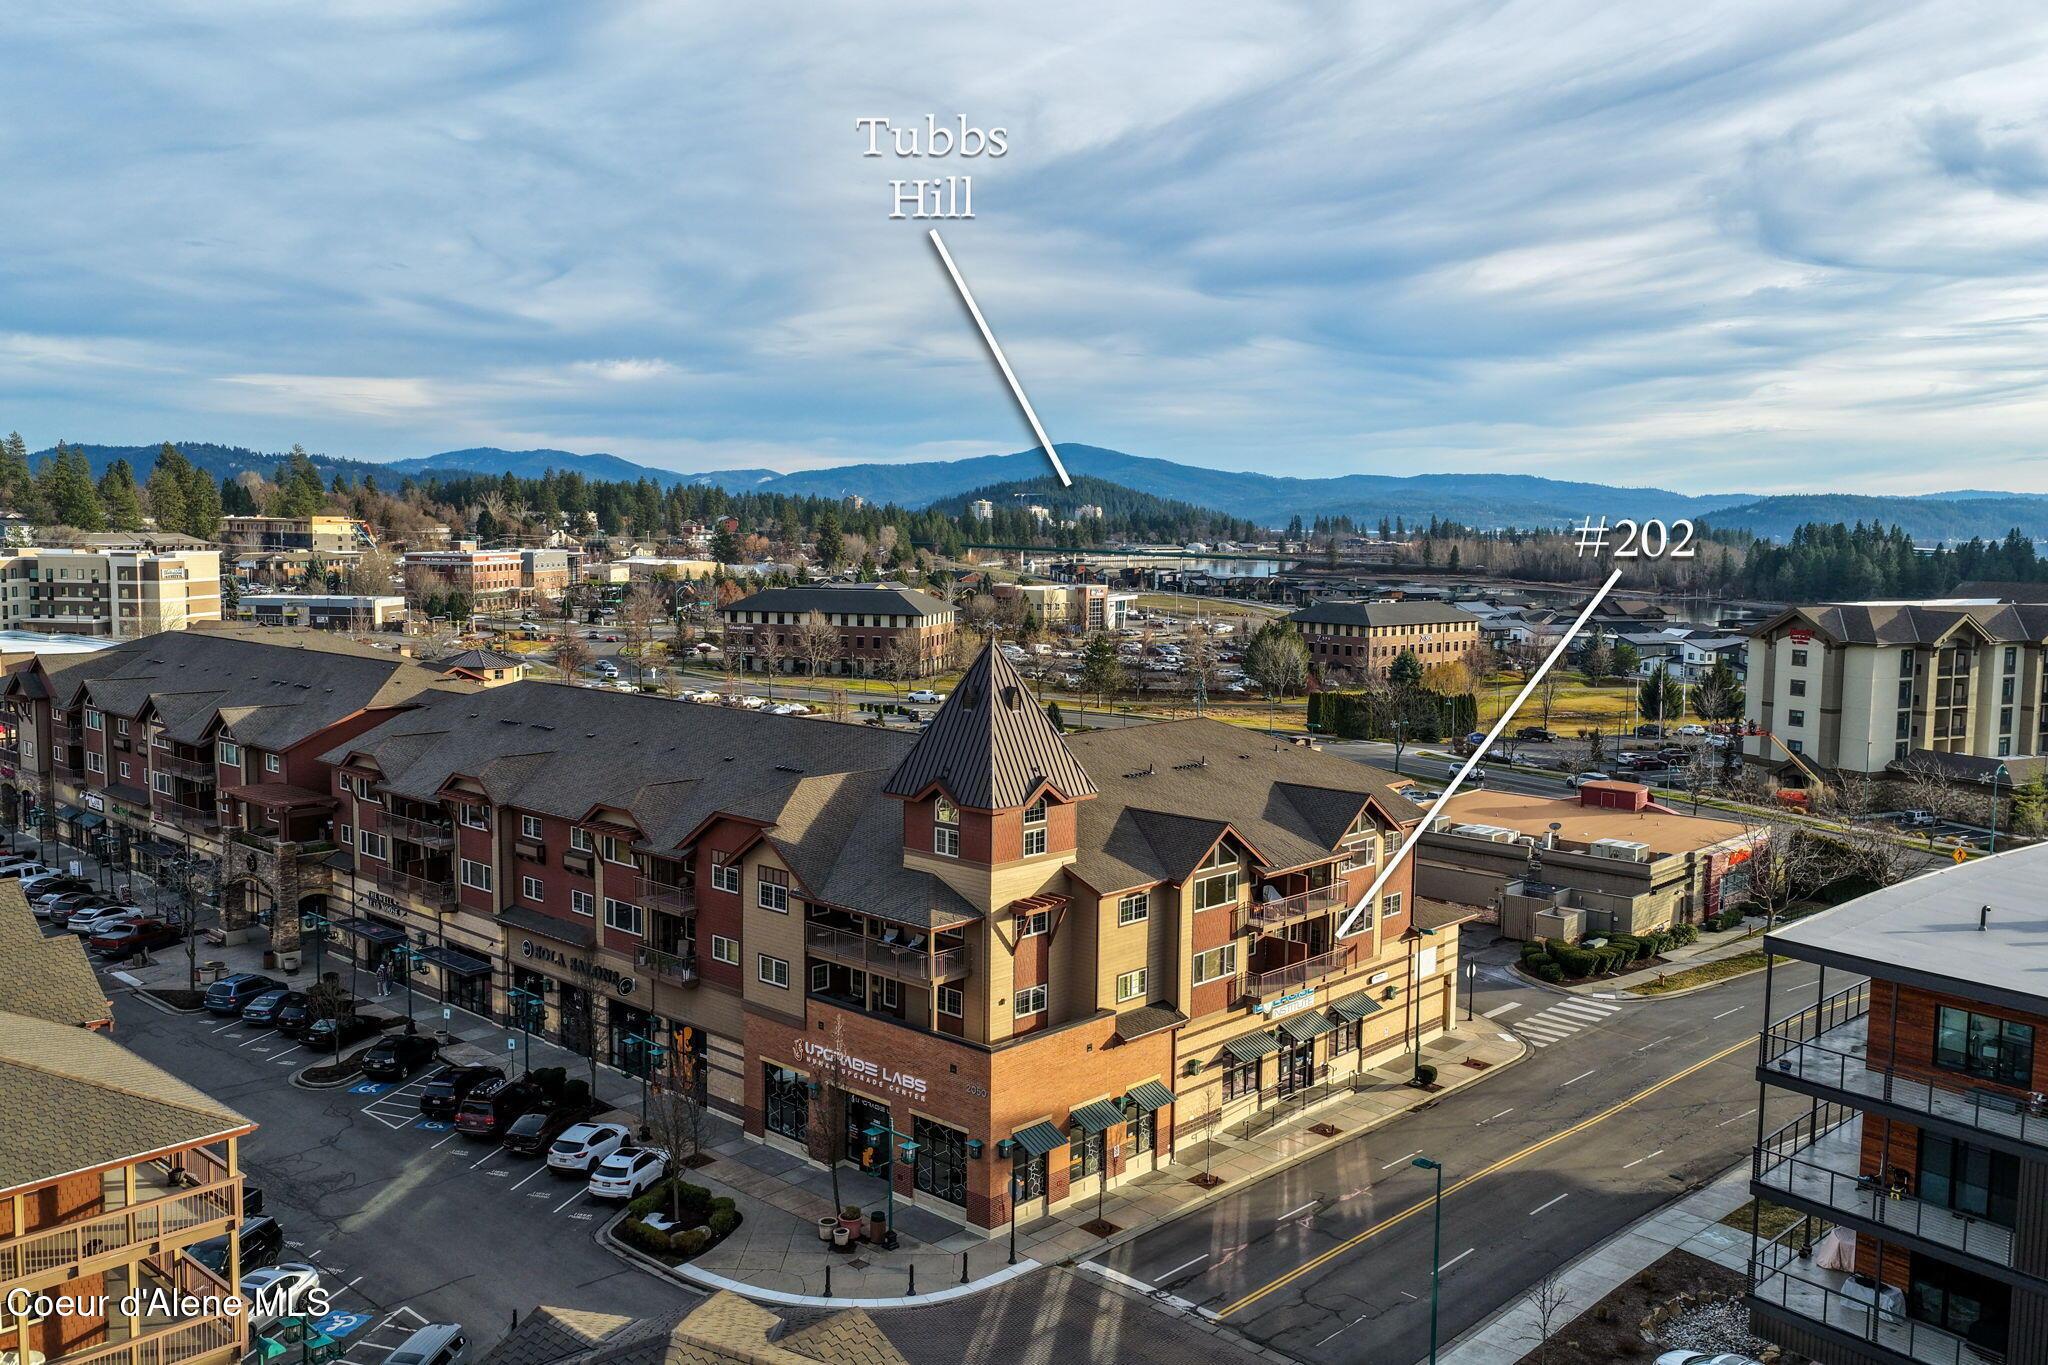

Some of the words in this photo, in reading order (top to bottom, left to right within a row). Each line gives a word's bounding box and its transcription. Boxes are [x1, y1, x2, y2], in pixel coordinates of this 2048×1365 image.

[804, 1041, 878, 1077] UPGRADE
[882, 1067, 928, 1093] LABS
[841, 1068, 883, 1088] UPGRADE
[889, 1084, 926, 1102] CENTER
[966, 1084, 988, 1098] 2050
